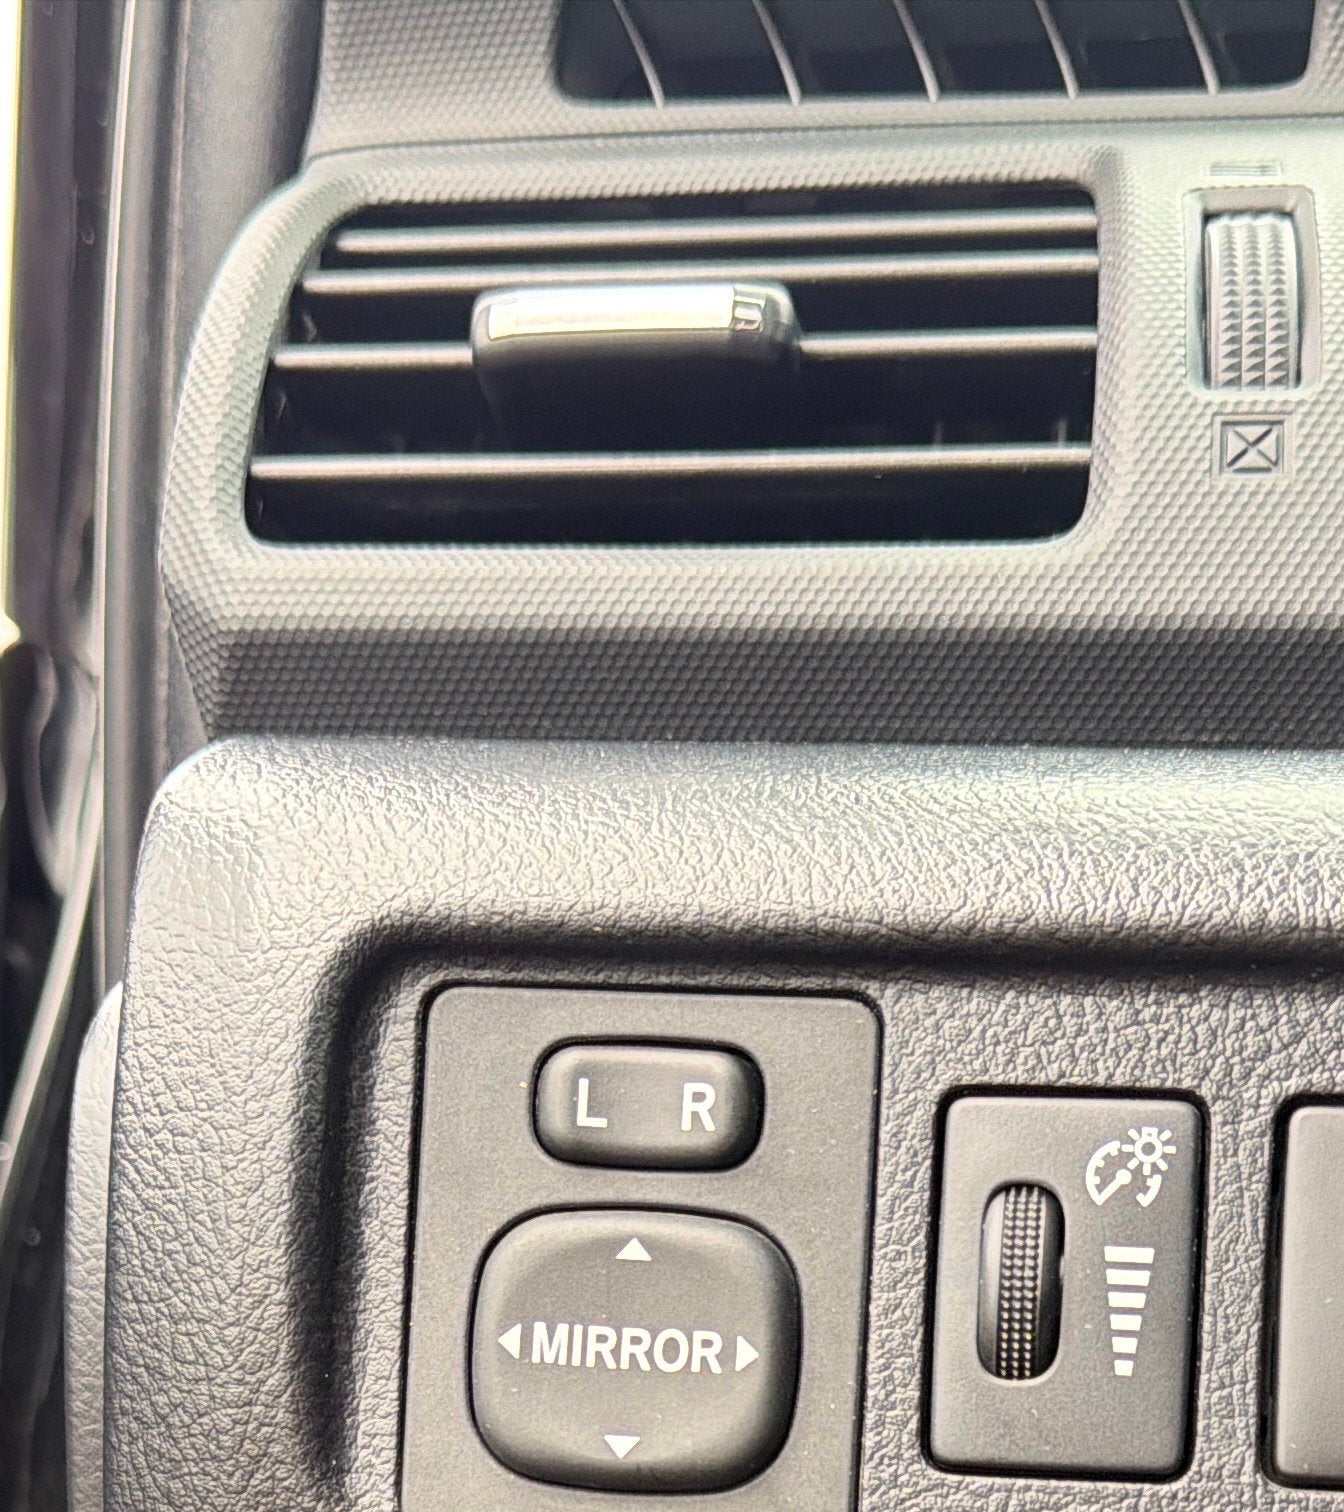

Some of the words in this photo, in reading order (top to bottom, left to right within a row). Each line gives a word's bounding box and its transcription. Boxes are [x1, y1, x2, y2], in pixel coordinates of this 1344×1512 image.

[575, 1077, 608, 1129] L
[680, 1081, 718, 1132] R
[530, 1321, 724, 1375] MIRROR
